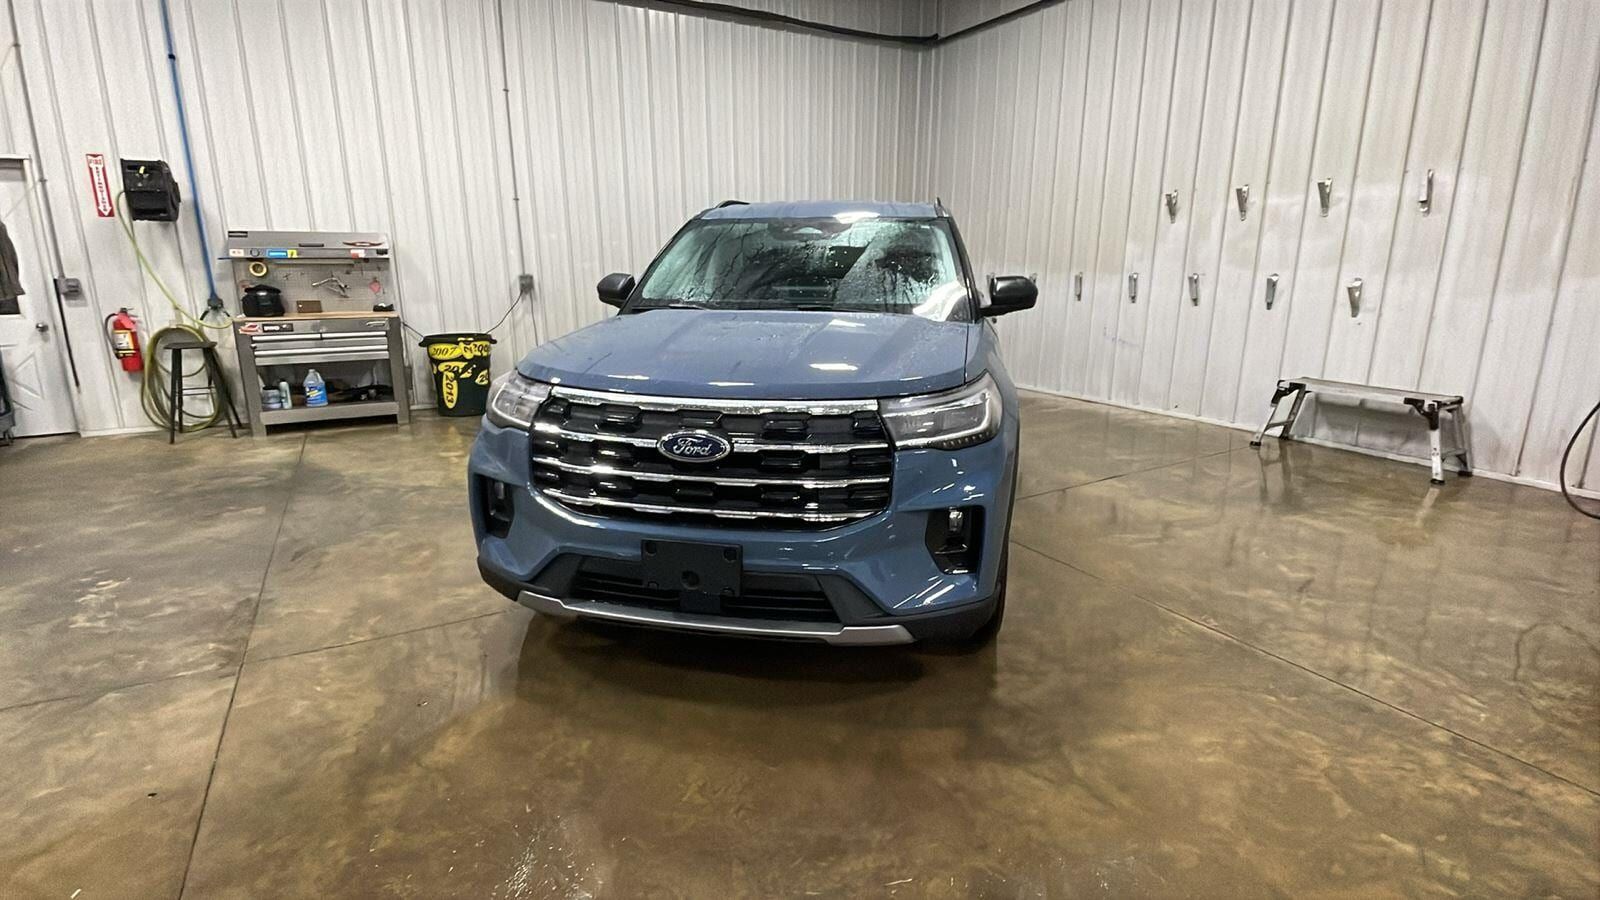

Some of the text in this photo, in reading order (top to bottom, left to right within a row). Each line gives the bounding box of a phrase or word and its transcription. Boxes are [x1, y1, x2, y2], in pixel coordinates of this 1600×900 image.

[432, 346, 457, 356] 2007
[446, 374, 455, 404] 2013
[673, 437, 712, 456] Ford
